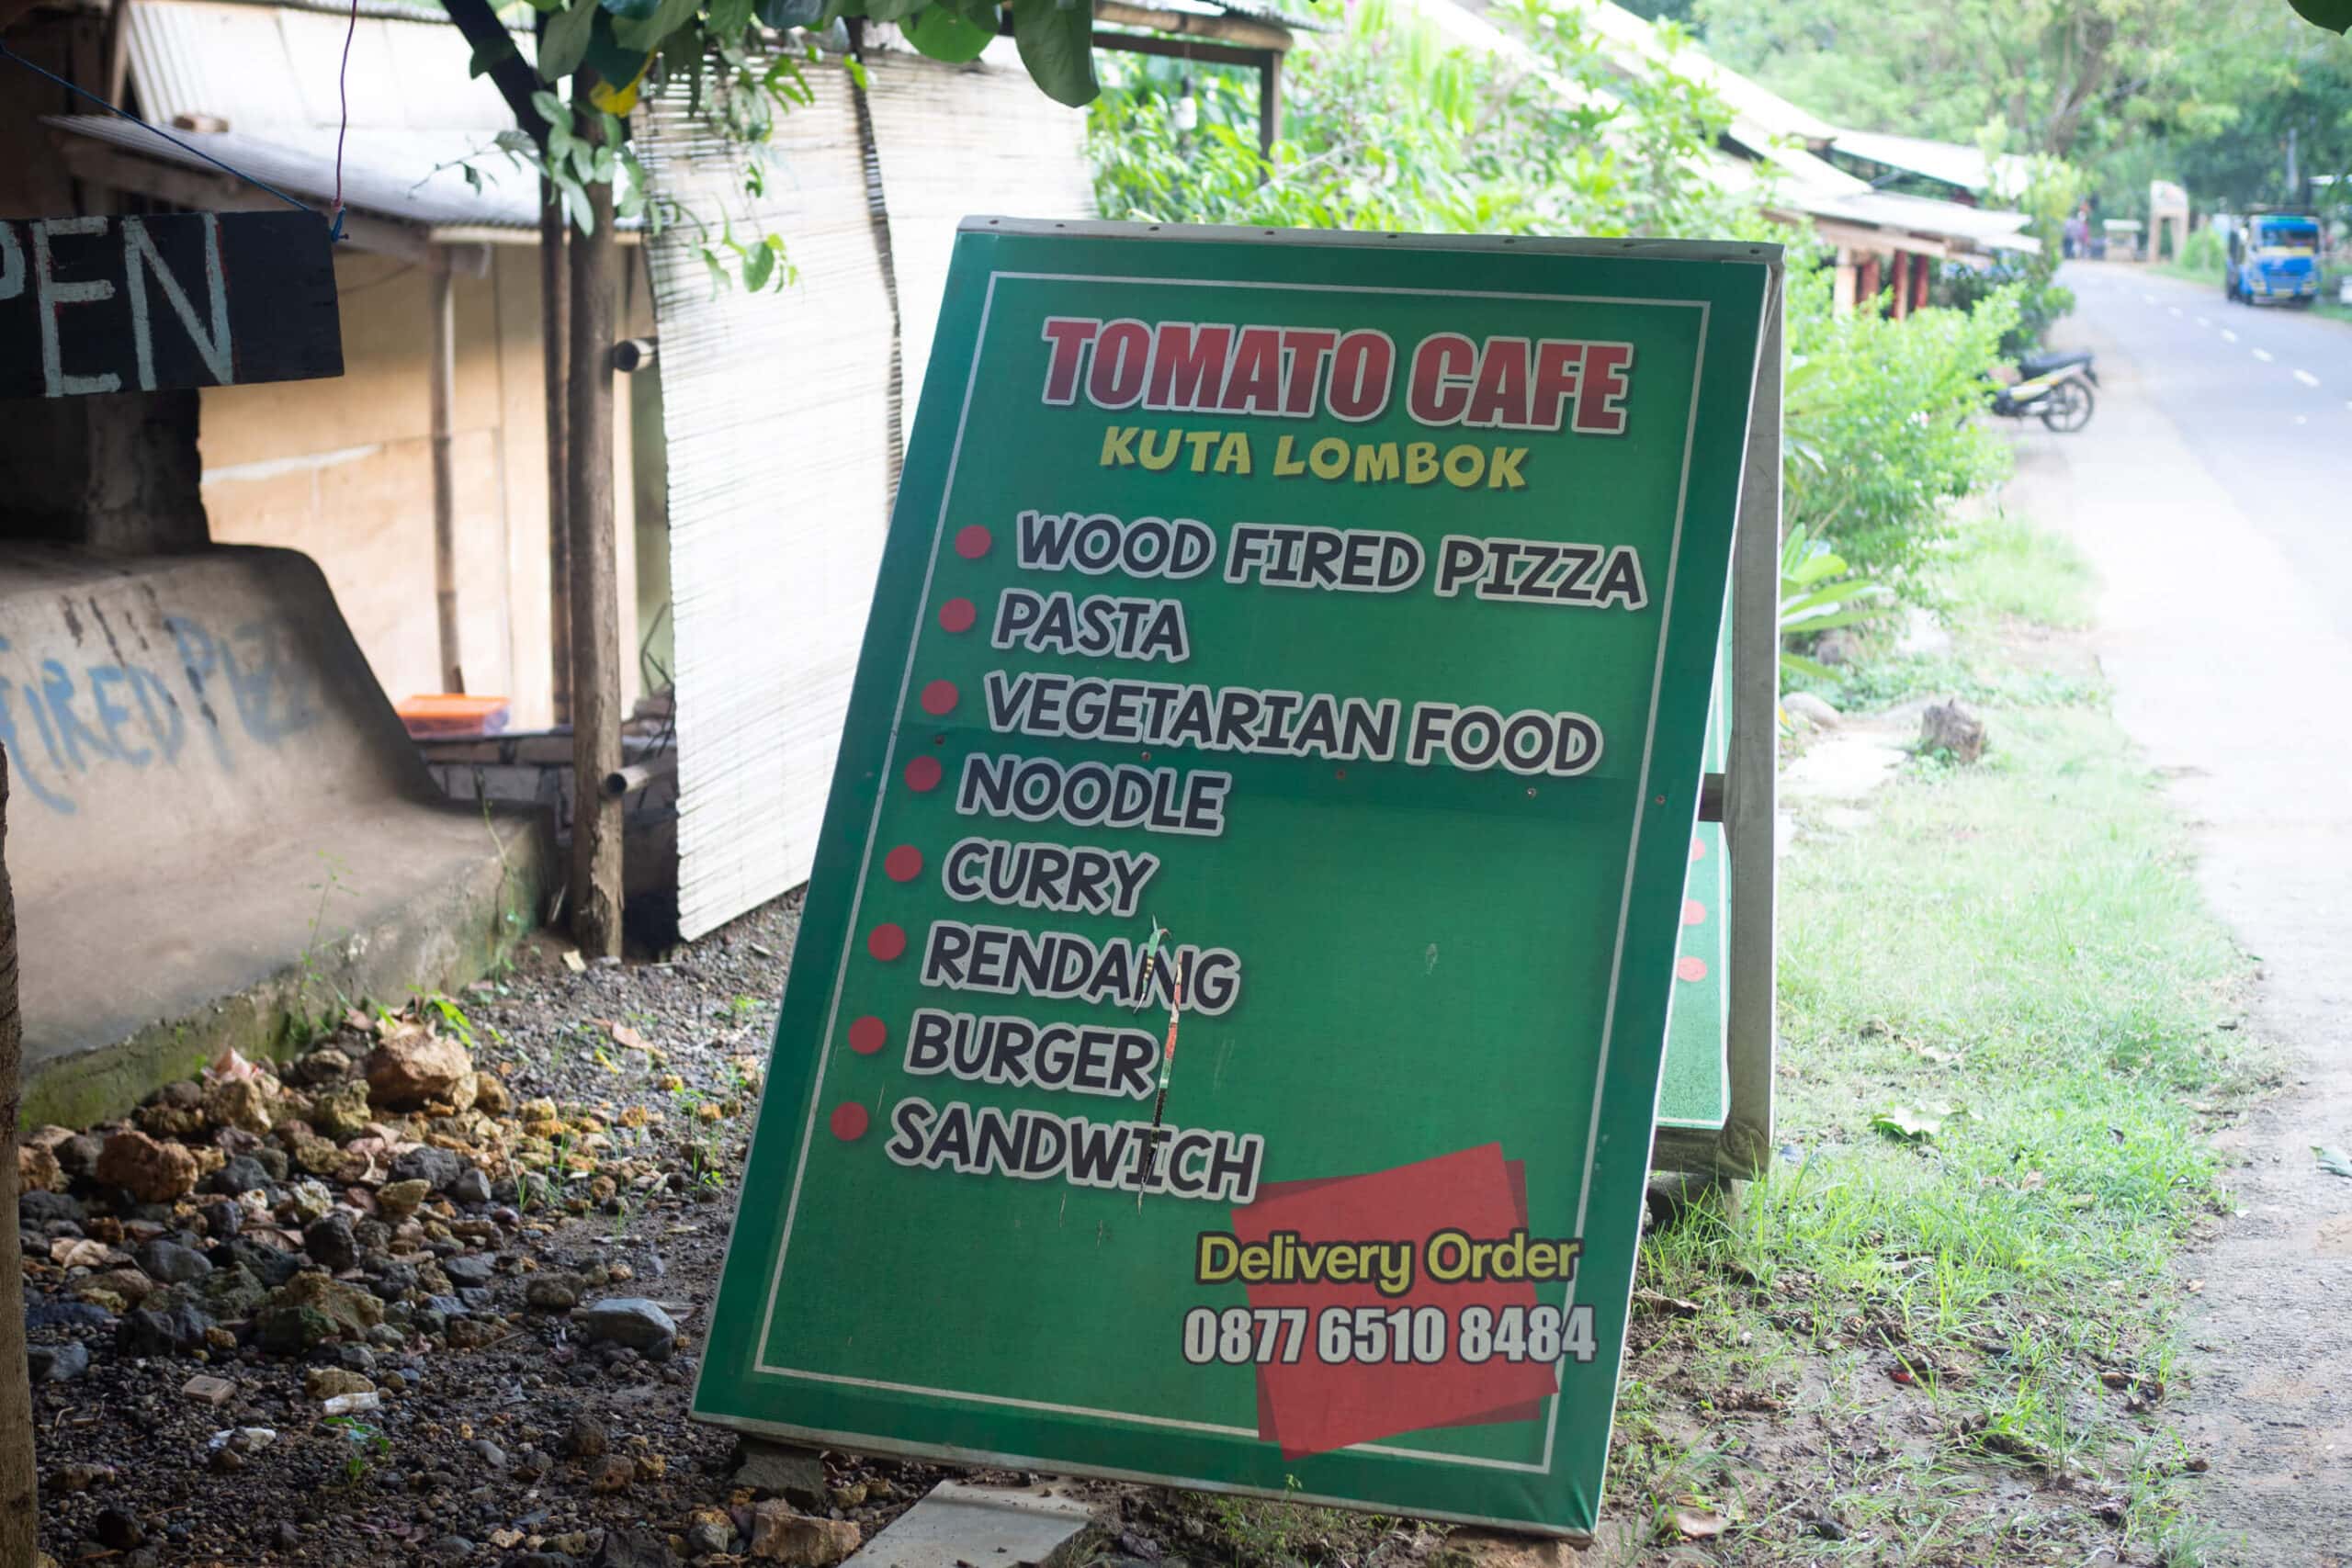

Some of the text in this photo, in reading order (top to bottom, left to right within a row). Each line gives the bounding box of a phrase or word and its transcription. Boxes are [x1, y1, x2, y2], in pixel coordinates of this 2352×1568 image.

[1042, 318, 1634, 434] TOMATO CAFE
[1101, 427, 1529, 490] KUTA LOMBOK
[1017, 511, 1648, 610] WOOD FIRED PIZZA
[992, 590, 1189, 662] PASTA
[985, 671, 1603, 777] VEGETARIAN FOOD
[957, 752, 1231, 835] NOODLE
[944, 838, 1159, 916] CURRY
[920, 920, 1241, 1015] RENDANG
[904, 1009, 1159, 1100] BURGER
[885, 1097, 1264, 1203] SANDWICH
[1195, 1229, 1583, 1292] Delivery Order
[1182, 1307, 1597, 1365] 0877 6510 8484
